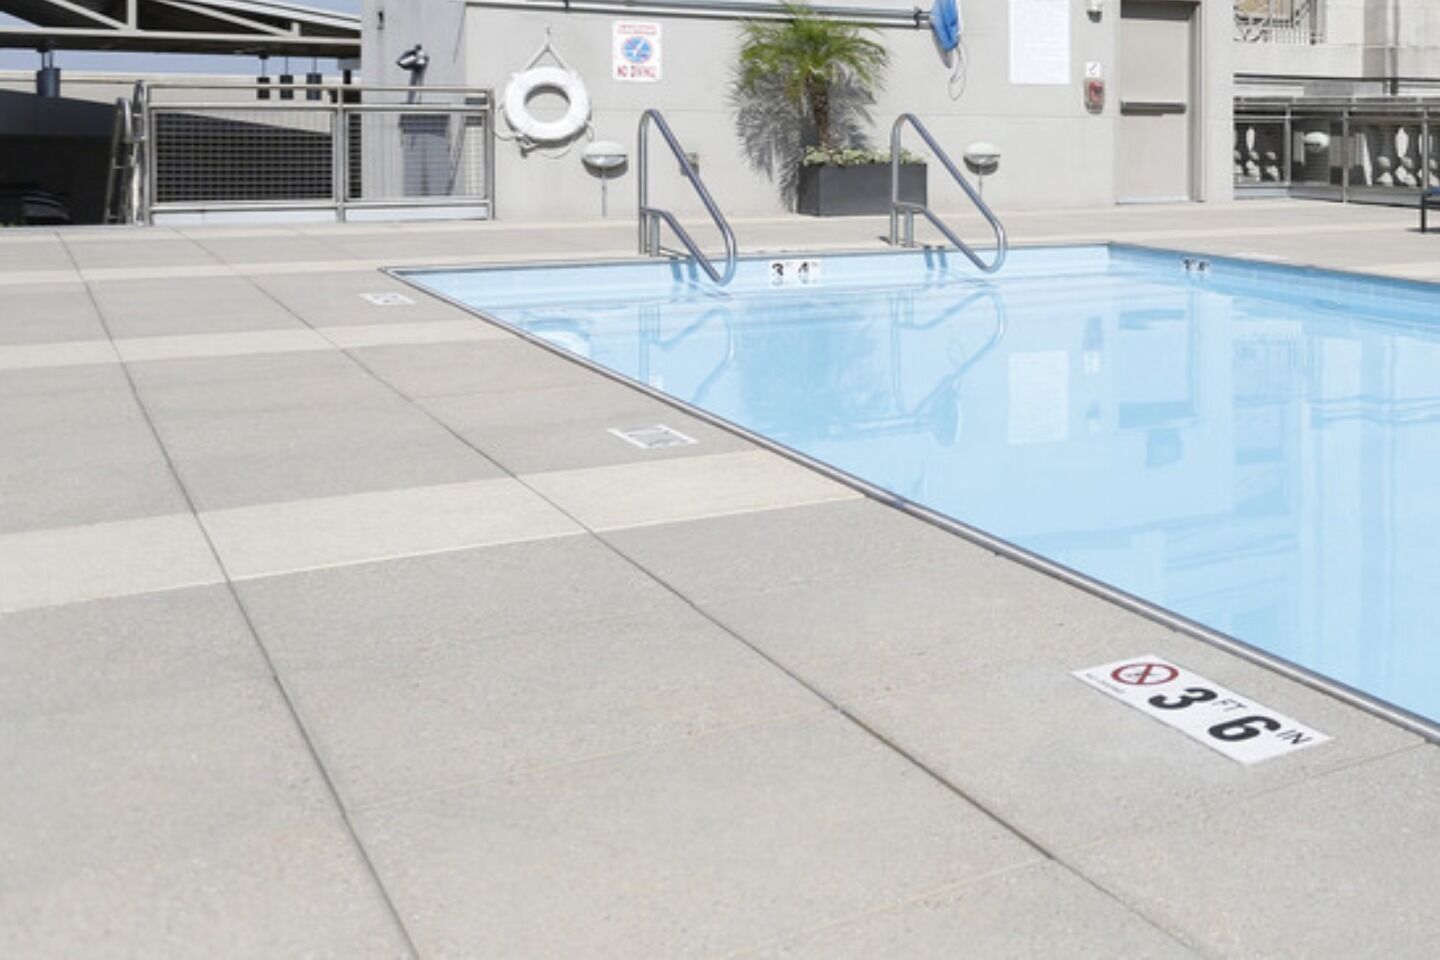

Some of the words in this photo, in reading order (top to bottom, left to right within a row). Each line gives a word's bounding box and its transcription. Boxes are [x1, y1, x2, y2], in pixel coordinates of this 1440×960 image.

[1147, 687, 1218, 710] 3
[1208, 715, 1281, 742] 6
[1275, 729, 1313, 745] IN
